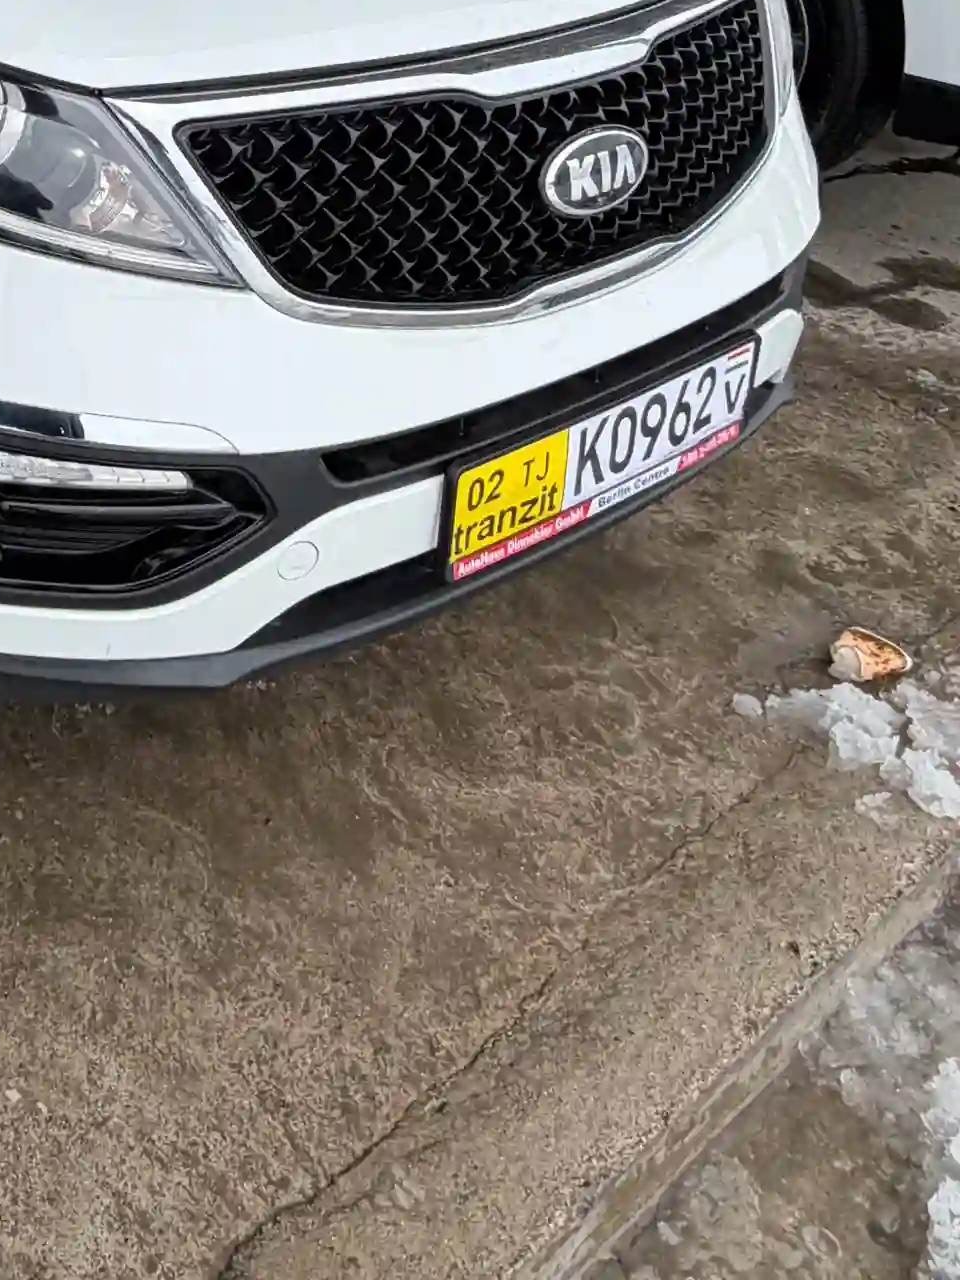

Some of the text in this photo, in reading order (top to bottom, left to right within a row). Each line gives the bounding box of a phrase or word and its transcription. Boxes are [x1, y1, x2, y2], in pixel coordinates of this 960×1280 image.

[566, 143, 637, 201] KIA
[574, 366, 716, 497] K0962
[725, 373, 746, 414] V
[467, 451, 550, 512] 02 TJ
[454, 482, 558, 555] tranzit
